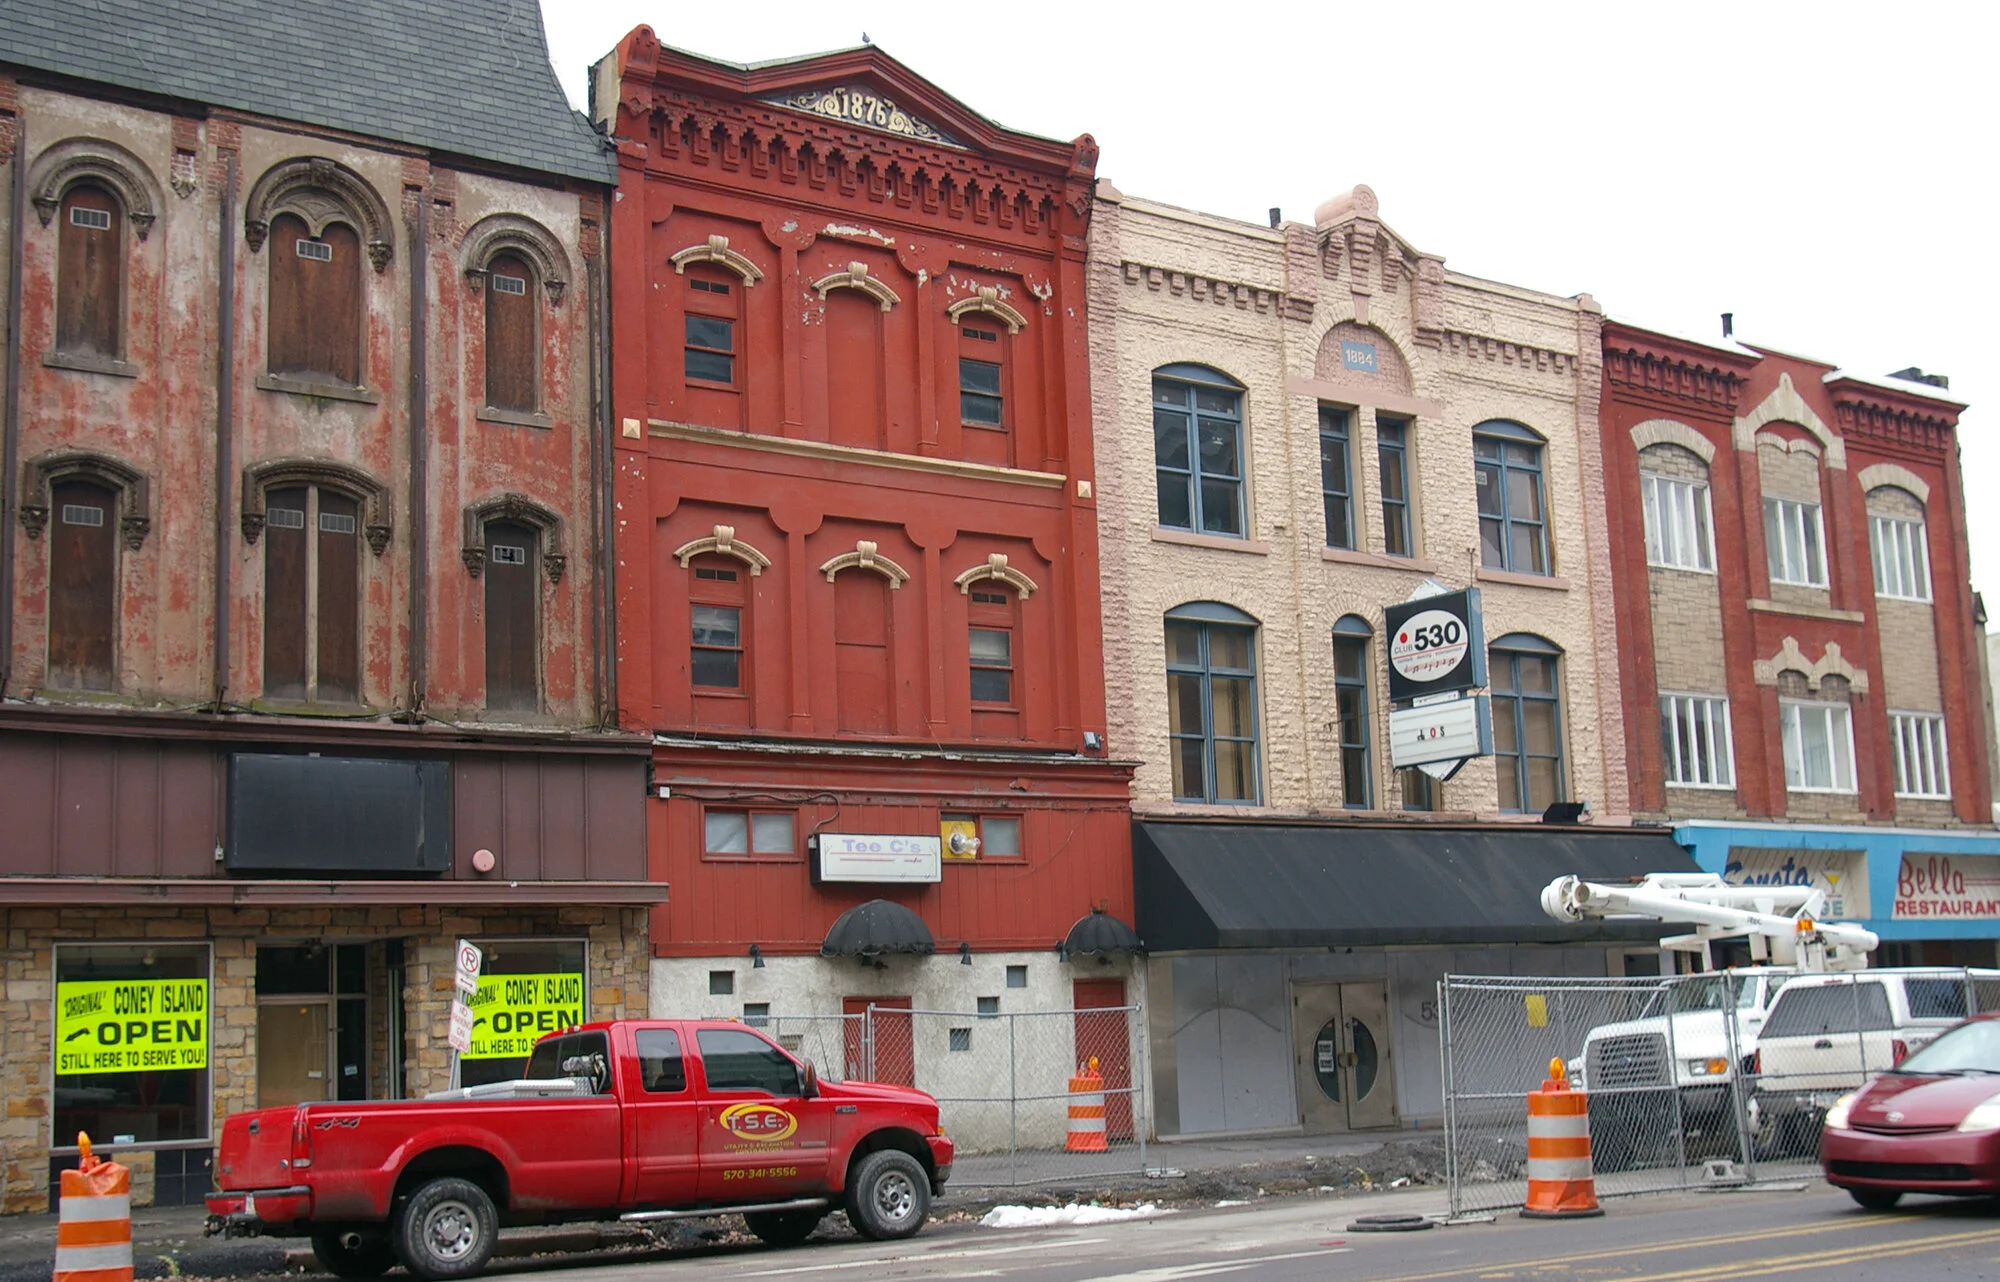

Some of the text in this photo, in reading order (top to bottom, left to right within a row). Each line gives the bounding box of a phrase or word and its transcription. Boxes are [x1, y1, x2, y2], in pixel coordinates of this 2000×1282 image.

[842, 92, 887, 126] 1875
[1345, 348, 1373, 367] 1884
[1394, 620, 1461, 655] CLUB 530
[842, 839, 921, 853] Tee C's
[1898, 856, 1966, 898] Bella
[114, 985, 155, 1015] CONEY
[160, 984, 204, 1013] ISLAND
[505, 979, 539, 1006] CONEY
[544, 978, 580, 1004] ISLAND
[98, 1019, 201, 1045] OPEN
[492, 1009, 578, 1034] OPEN
[61, 1048, 205, 1070] STILL HERE TO SERVE YOU!
[470, 1040, 487, 1054] TILL
[491, 1039, 514, 1054] HERE
[516, 1038, 528, 1053] TO
